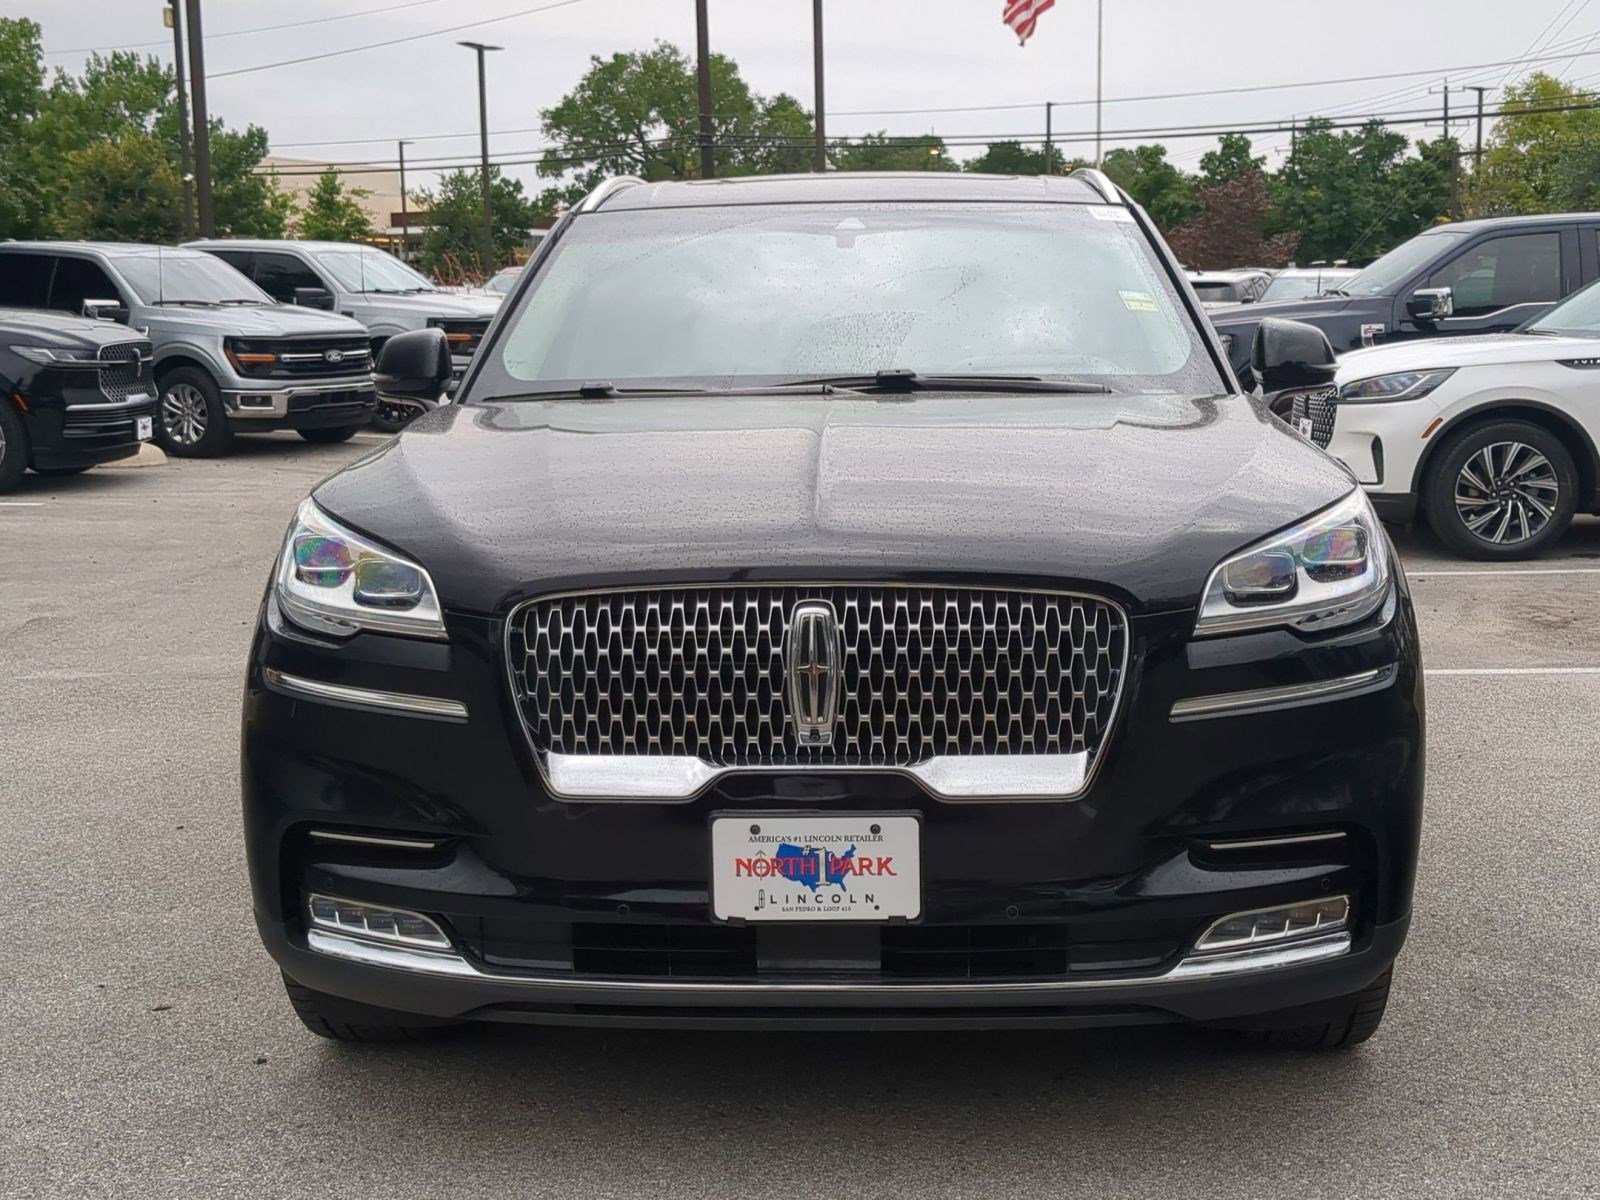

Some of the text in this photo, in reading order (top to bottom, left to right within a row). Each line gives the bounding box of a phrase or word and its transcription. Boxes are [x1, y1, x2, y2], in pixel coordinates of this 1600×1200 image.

[328, 351, 342, 361] Ford
[748, 834, 884, 843] AMERICA'S #1 LINCOLN RETAILER
[736, 857, 897, 877] NORTH PARK
[770, 893, 874, 904] LINCOLN
